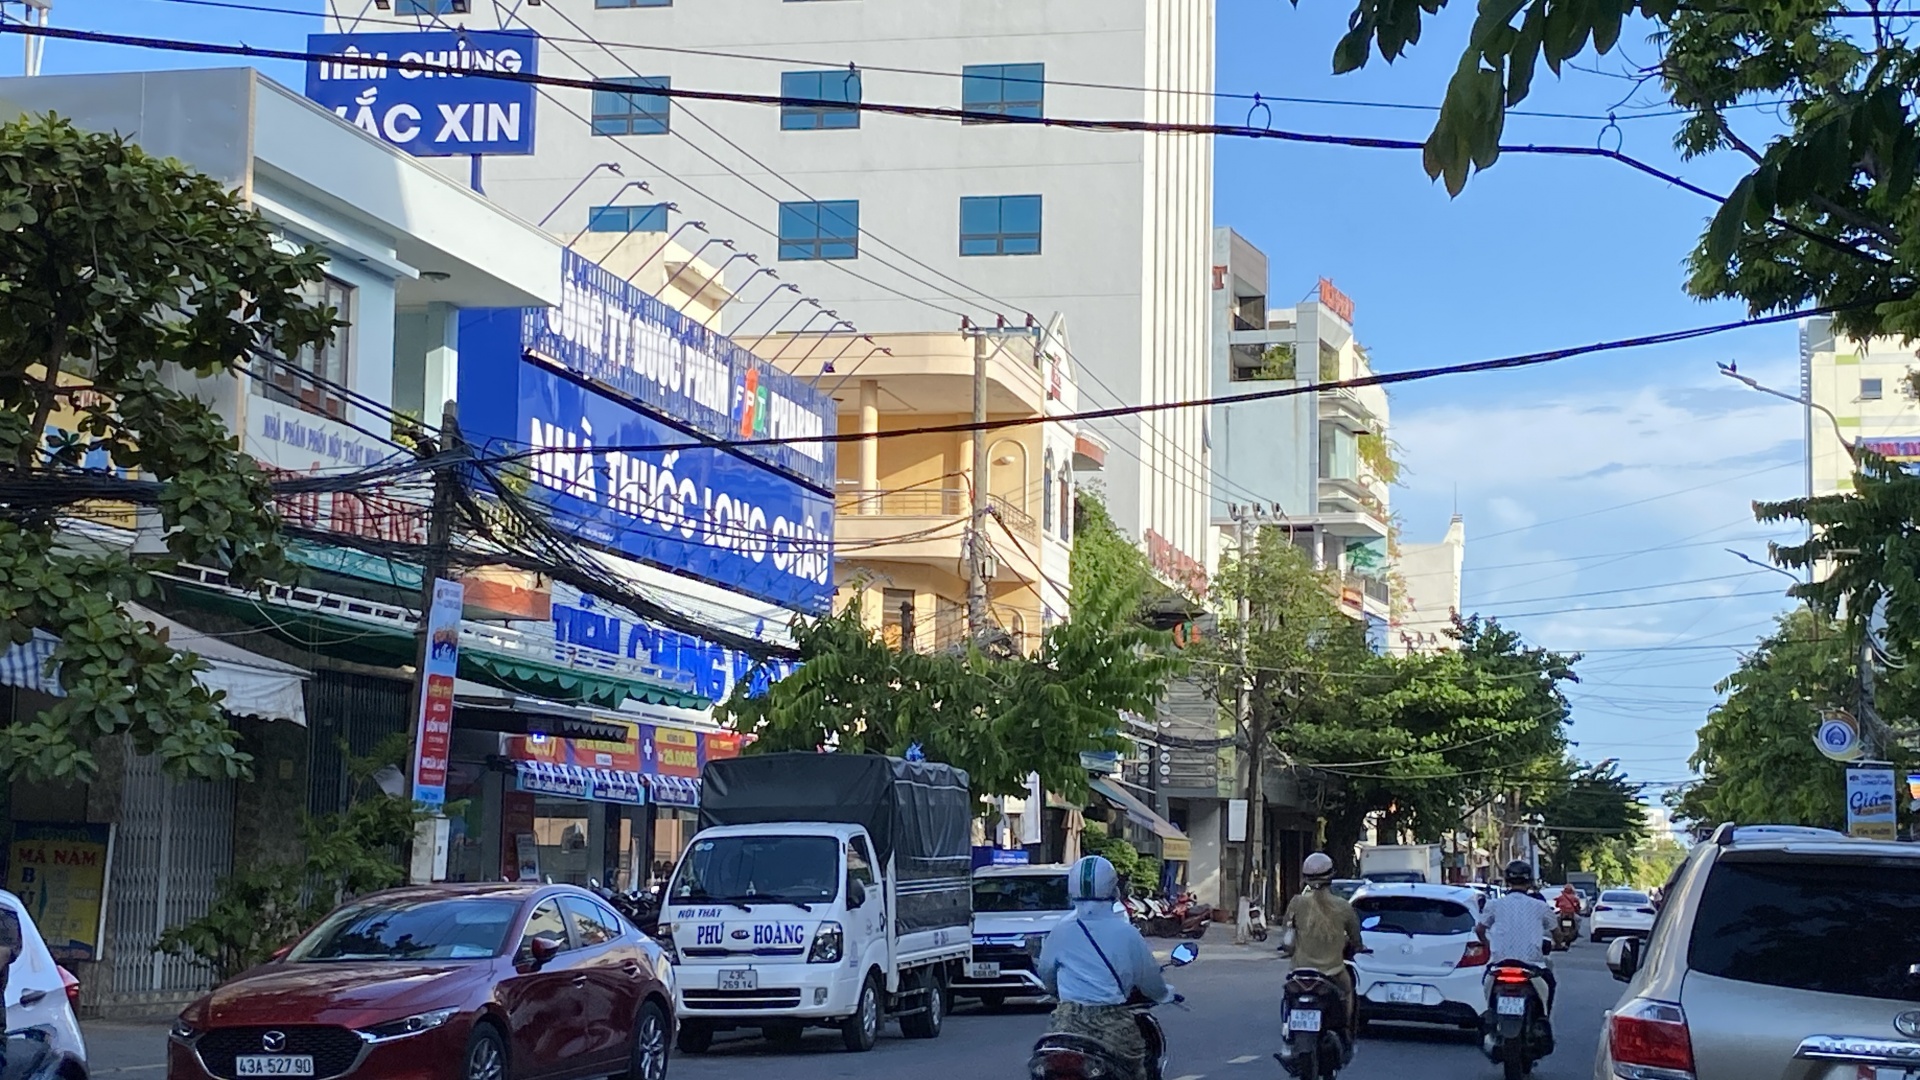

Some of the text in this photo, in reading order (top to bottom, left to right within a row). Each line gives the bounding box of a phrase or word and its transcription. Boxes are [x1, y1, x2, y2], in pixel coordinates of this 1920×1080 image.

[319, 39, 522, 80] TIÊM CHỦNG
[435, 103, 520, 142] XIN
[607, 302, 631, 376] TY
[733, 380, 767, 424] FPT
[530, 418, 829, 586] NHÀ THUỐC LONG CHÂU
[697, 921, 804, 945] PHÚ HOÀNG
[729, 971, 746, 980] 43C
